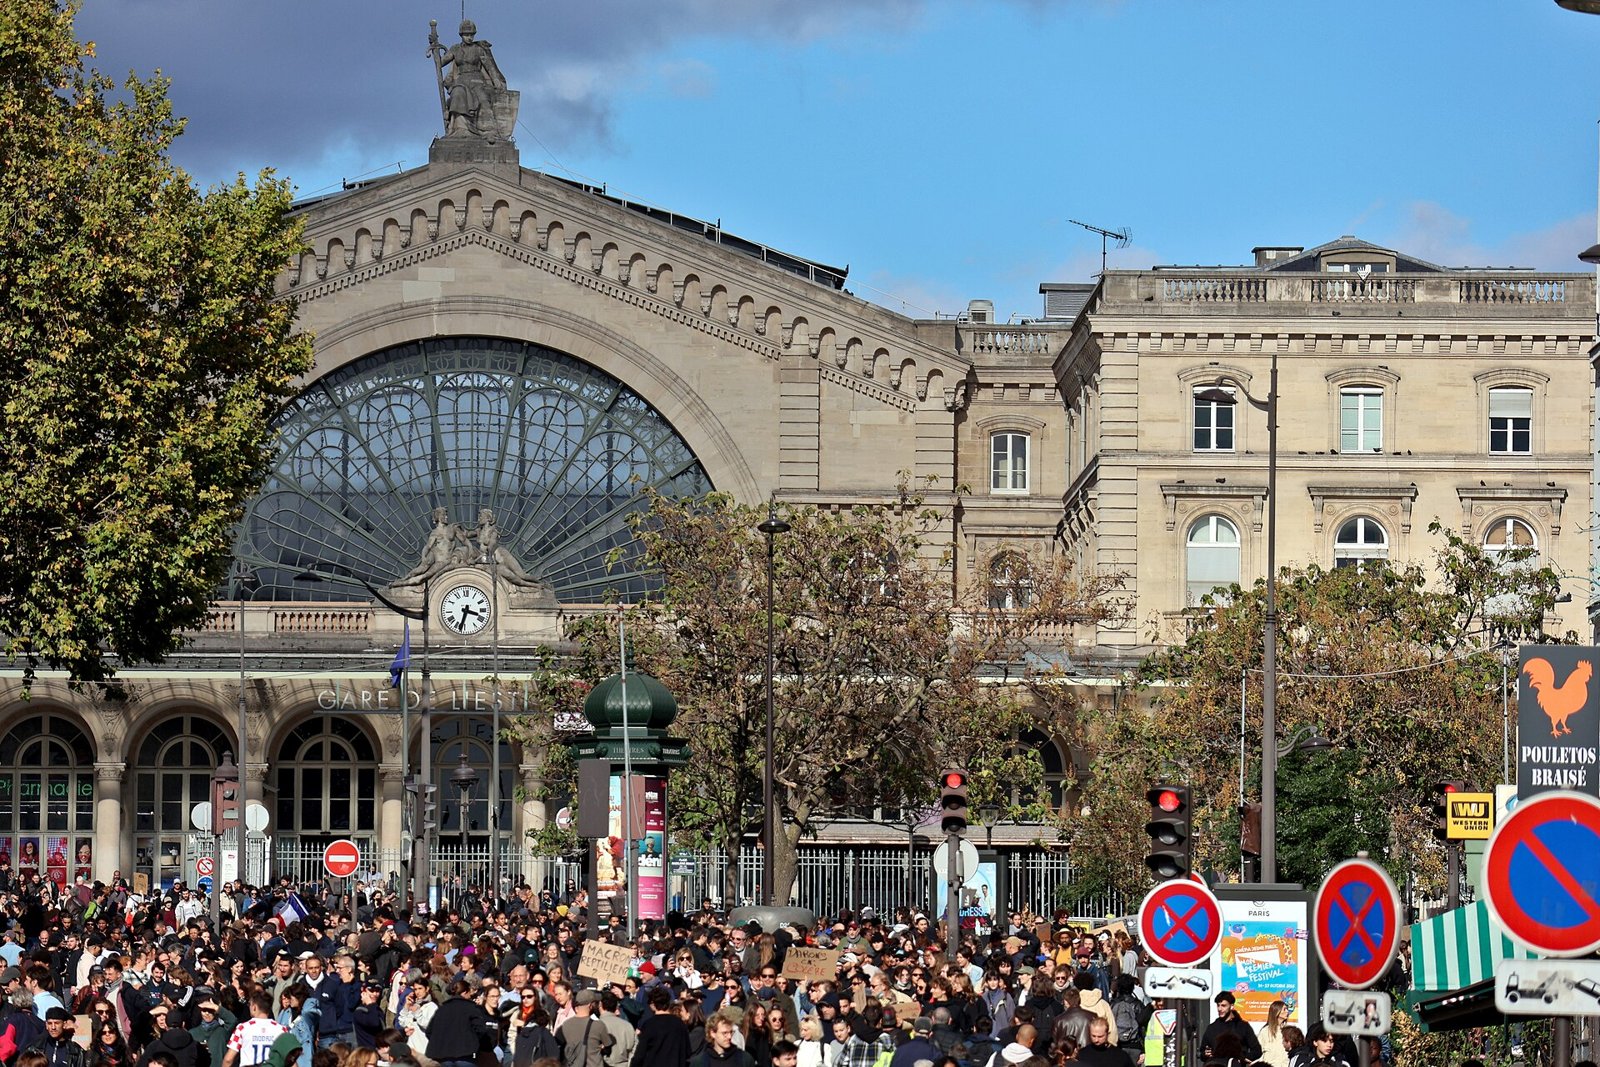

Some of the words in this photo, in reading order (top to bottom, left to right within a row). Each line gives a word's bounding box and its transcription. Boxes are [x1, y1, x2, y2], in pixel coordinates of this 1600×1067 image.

[317, 690, 389, 710] GARE
[1521, 746, 1597, 765] POULETOS
[1531, 766, 1587, 786] BRAISÉ
[1453, 803, 1485, 817] WU
[638, 854, 662, 867] déni
[586, 944, 631, 963] MACRON
[1245, 963, 1275, 973] PREMIER
[1249, 968, 1284, 982] FESTIVAL
